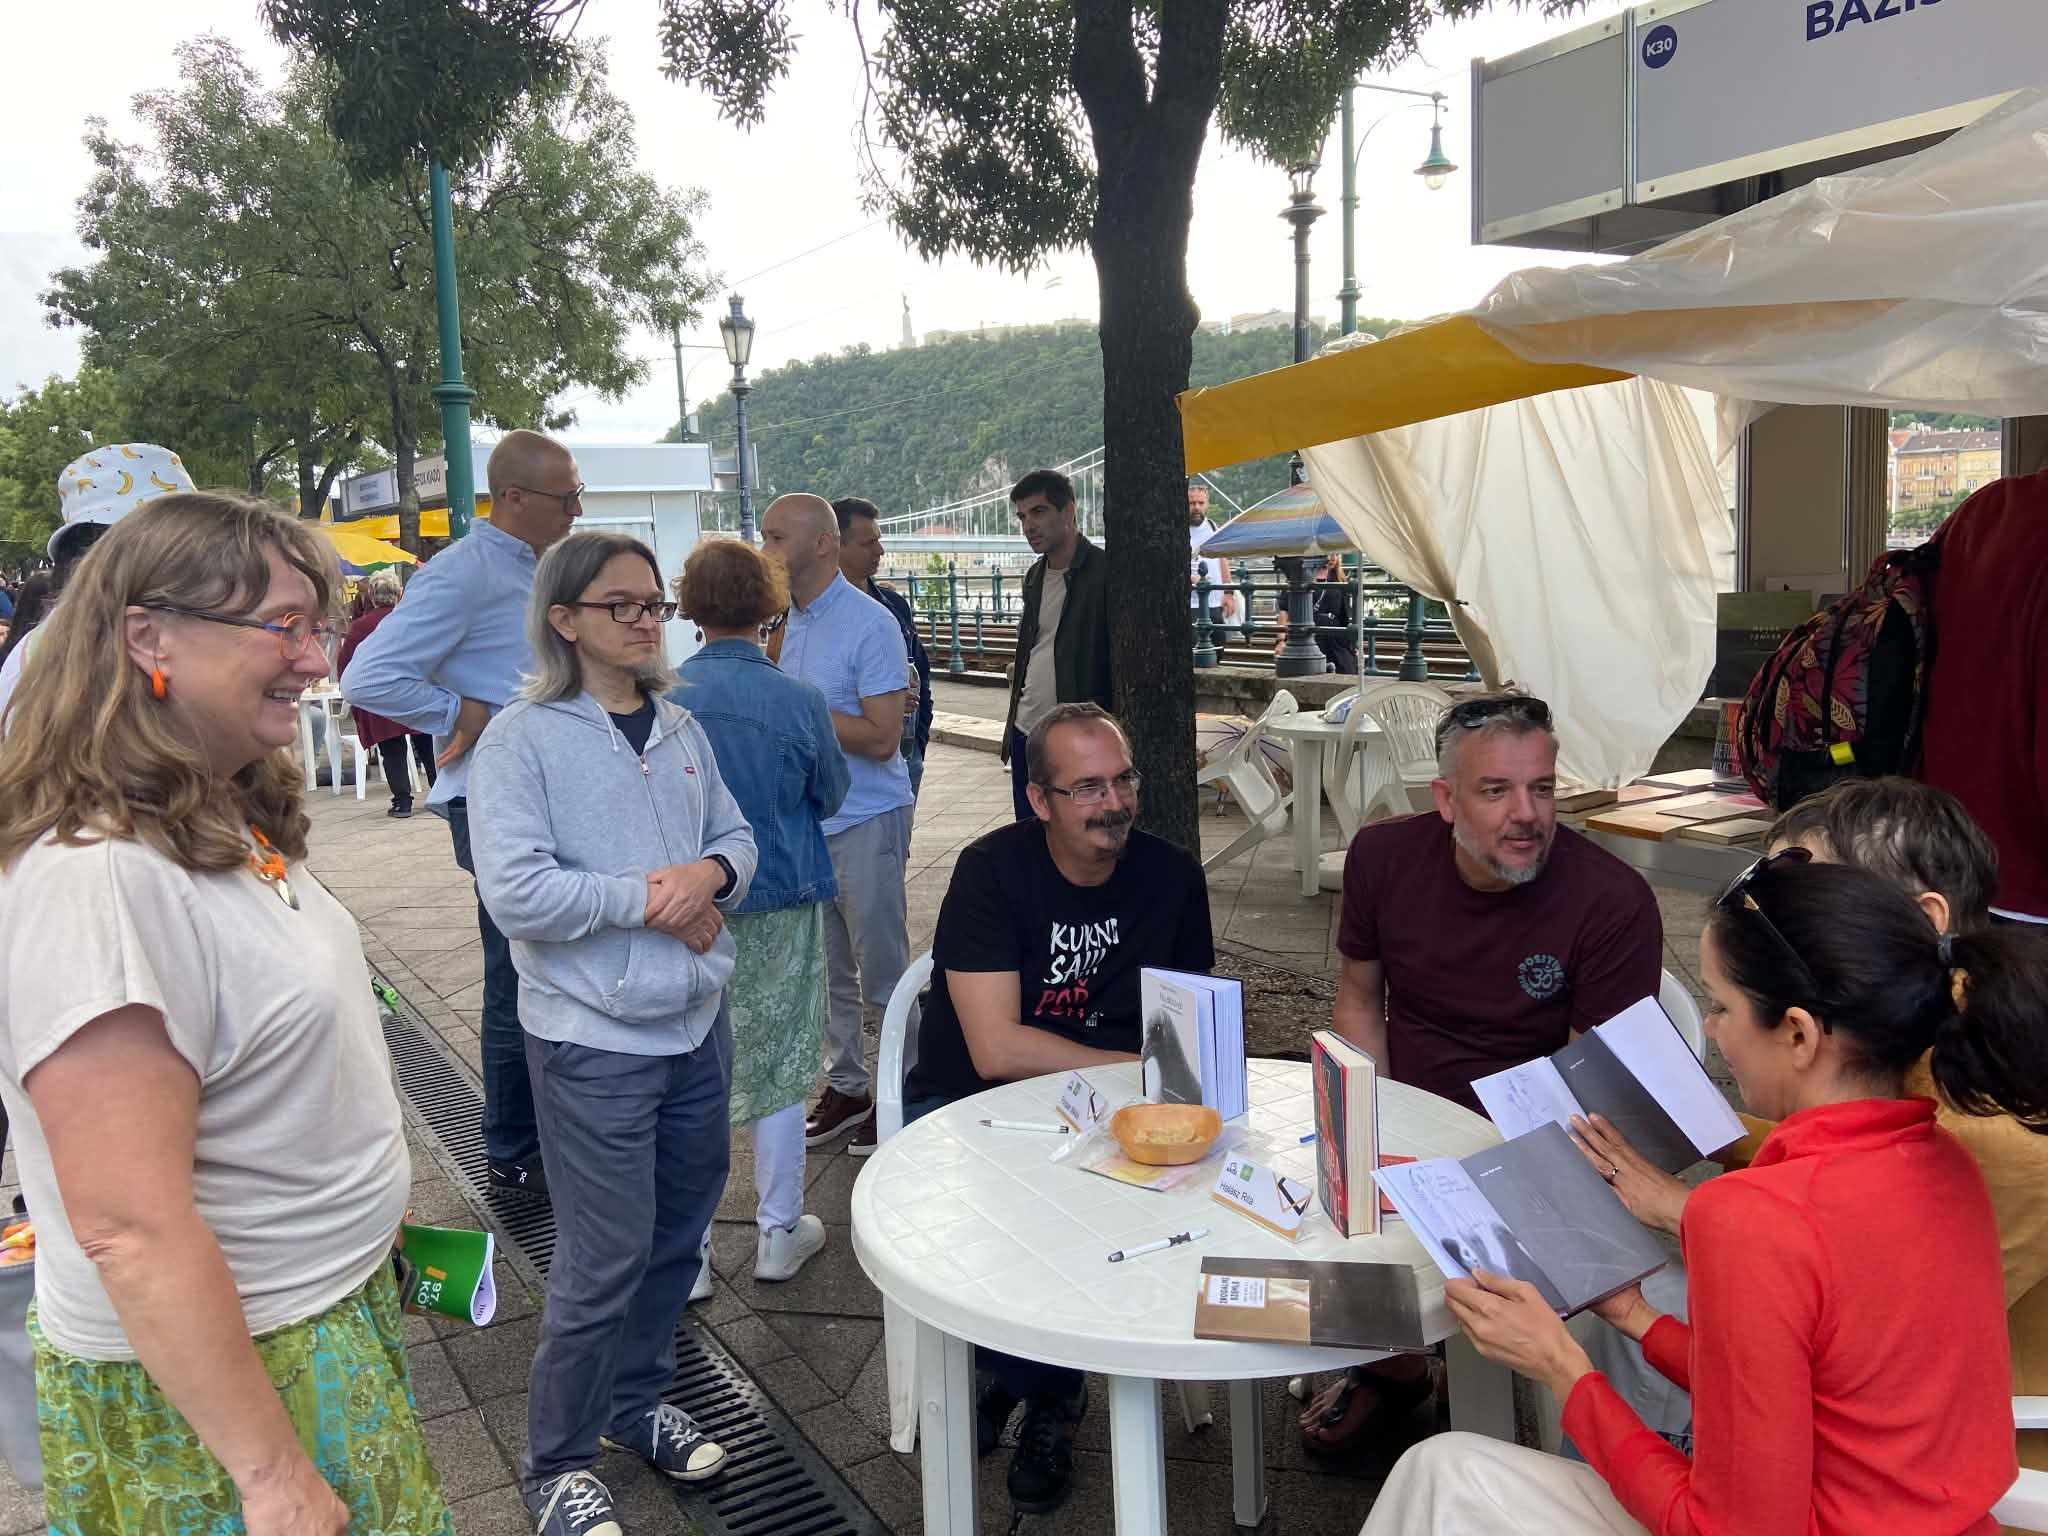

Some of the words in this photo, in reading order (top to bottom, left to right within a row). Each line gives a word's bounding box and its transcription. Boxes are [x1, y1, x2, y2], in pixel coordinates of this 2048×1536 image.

[1646, 37, 1673, 57] K30
[1050, 917, 1120, 955] KUKNI
[1043, 948, 1107, 985] SA!!!
